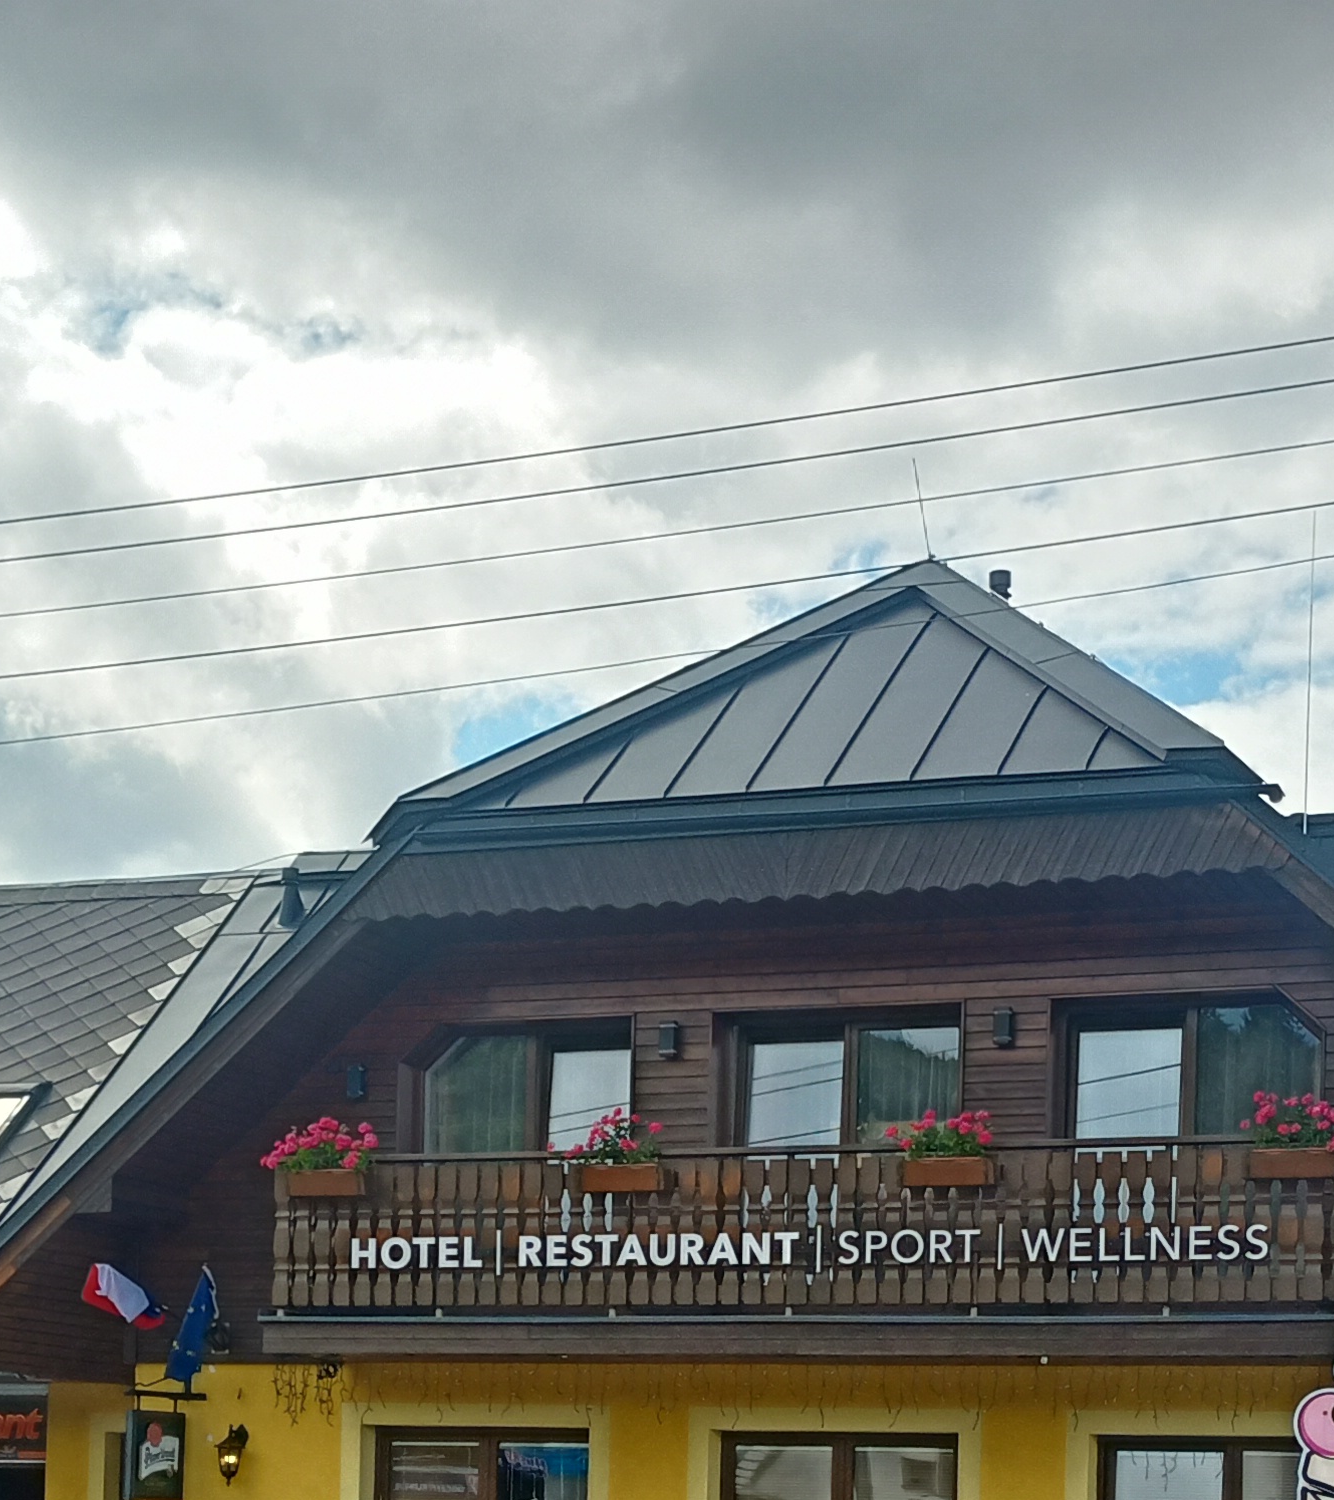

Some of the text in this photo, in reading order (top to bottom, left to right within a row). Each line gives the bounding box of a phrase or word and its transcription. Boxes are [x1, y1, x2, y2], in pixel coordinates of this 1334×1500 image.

[350, 1223, 1269, 1269] HOTEL RESTAURANT SPORT WELLNESS
